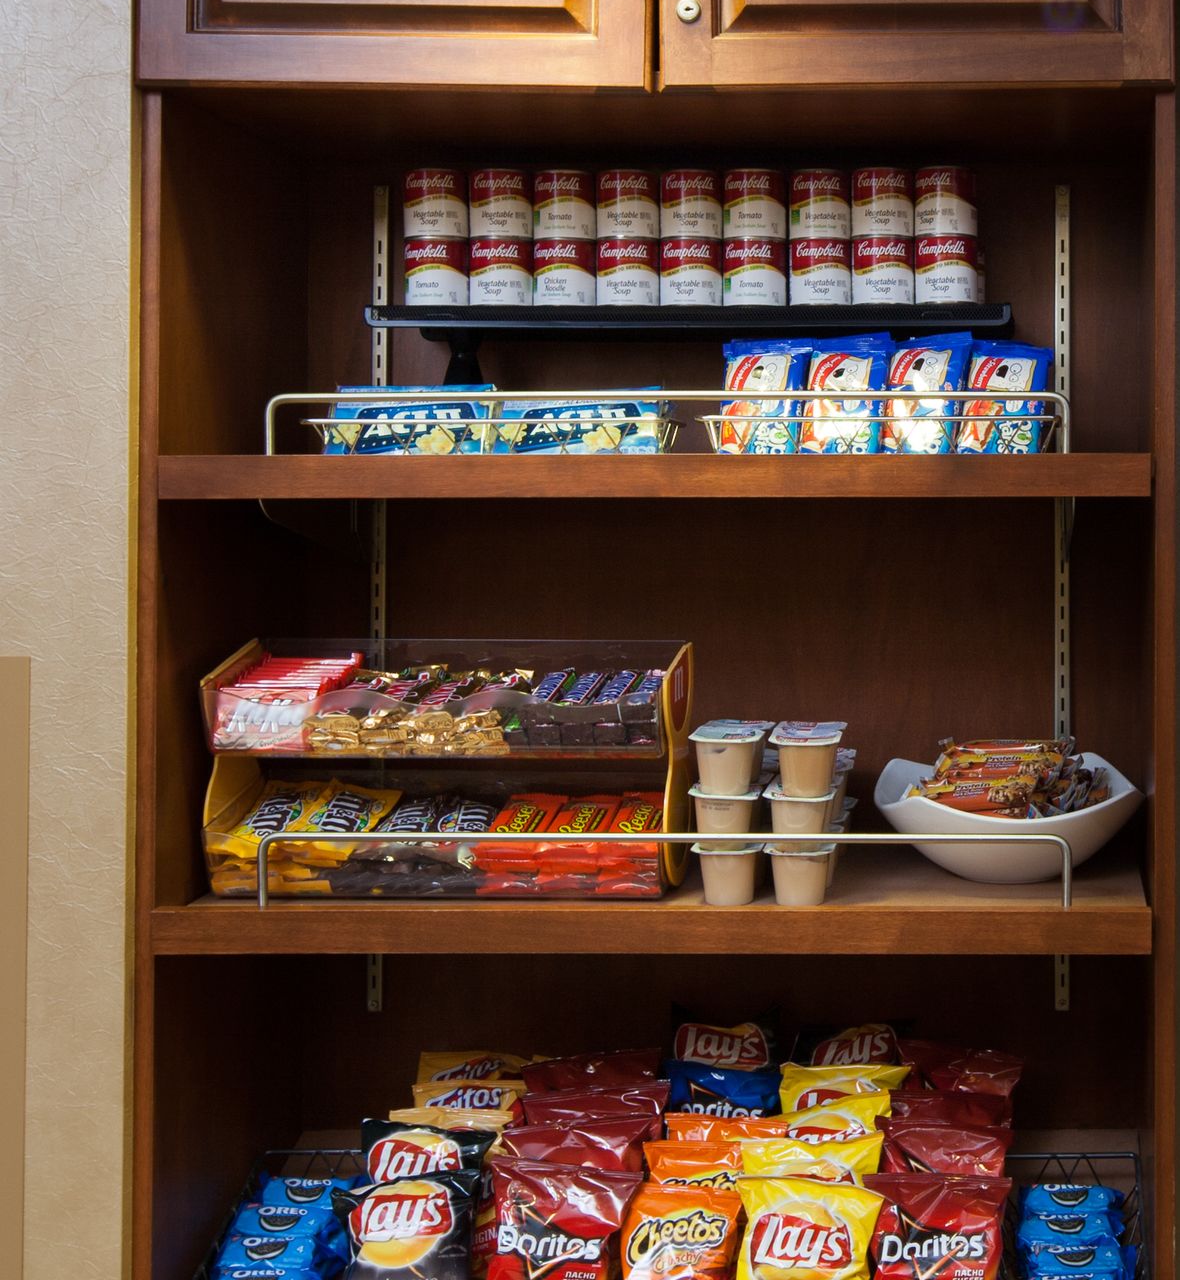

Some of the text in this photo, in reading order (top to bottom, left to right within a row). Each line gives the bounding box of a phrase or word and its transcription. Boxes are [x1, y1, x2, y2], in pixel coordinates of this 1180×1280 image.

[406, 173, 454, 190] Campbell's
[474, 173, 522, 190] Campbell's
[535, 176, 580, 192] Campbell's
[600, 174, 647, 191] Campbell's
[666, 174, 713, 191] Campbell's
[724, 175, 770, 192] Campbell's
[793, 176, 840, 192] Campbell's
[857, 172, 905, 189] Campbell's
[489, 218, 507, 227] Soup
[547, 212, 572, 221] Tomato
[614, 219, 632, 228] Soup
[738, 211, 762, 220] Tomato
[873, 217, 890, 227] Soup
[472, 243, 519, 260] Campbell's
[600, 242, 647, 260] Campbell's
[663, 243, 710, 260] Campbell's
[725, 243, 771, 260] Campbell's
[796, 241, 845, 259] Campbell's
[857, 240, 906, 258] Campbell's
[918, 239, 965, 257] Campbell's
[415, 281, 439, 289] Tomato
[484, 287, 502, 296] Soup
[613, 287, 631, 296] Soup
[739, 280, 764, 288] Tomato
[873, 285, 890, 294] Soup
[363, 409, 429, 439] ACT
[529, 409, 594, 436] ACT
[985, 754, 1023, 763] Protein
[953, 782, 991, 792] Protein
[683, 1026, 761, 1066] Lay's
[820, 1032, 891, 1067] Lay's
[258, 1206, 309, 1217] OREO
[360, 1193, 445, 1243] Lay's
[496, 1222, 602, 1263] Doritos
[628, 1211, 726, 1263] Cheetos
[753, 1214, 847, 1269] Lay's
[880, 1231, 986, 1264] Doritos
[565, 1271, 597, 1280] NACHO
[954, 1269, 985, 1278] NACHO
